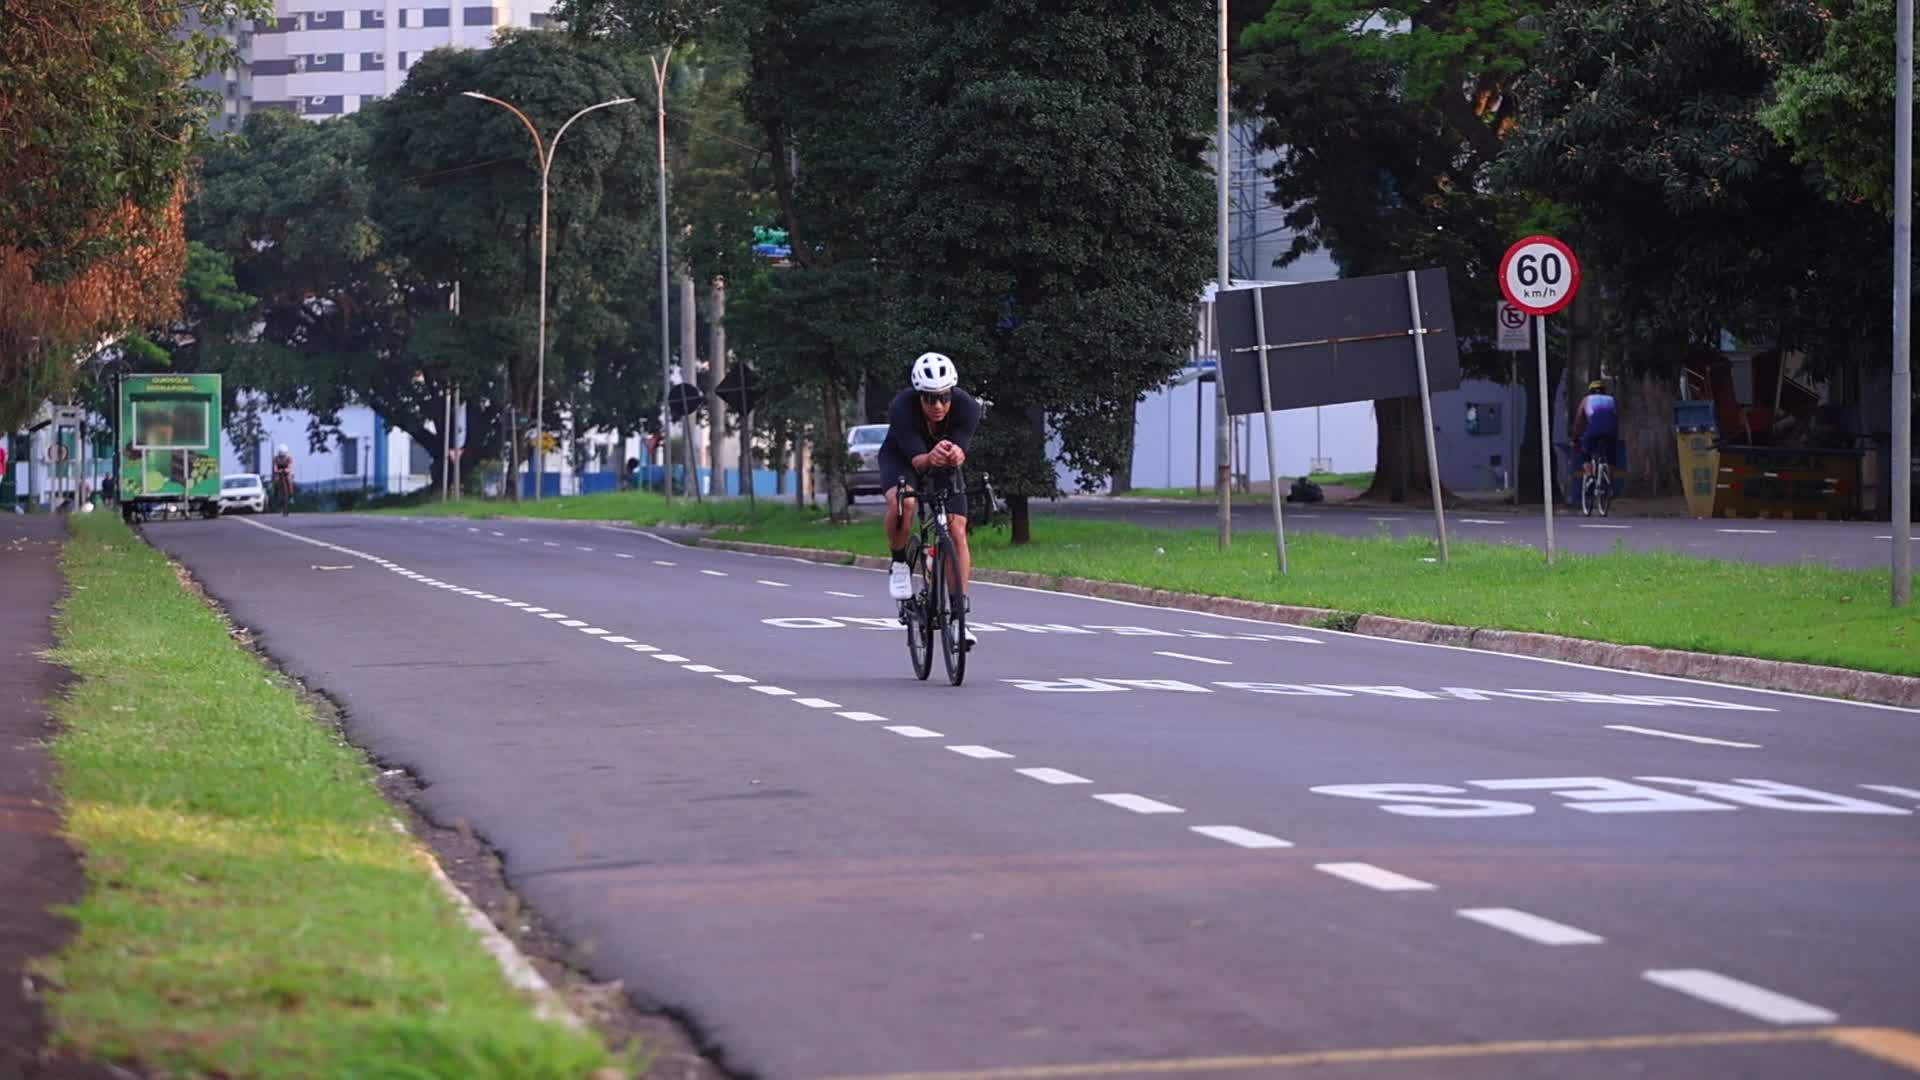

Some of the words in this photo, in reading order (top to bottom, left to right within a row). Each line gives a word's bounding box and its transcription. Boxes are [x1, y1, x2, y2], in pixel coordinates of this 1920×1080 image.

[1517, 252, 1562, 286] 60
[1523, 287, 1557, 299] km/h
[1002, 678, 1780, 711] DEVAGAR
